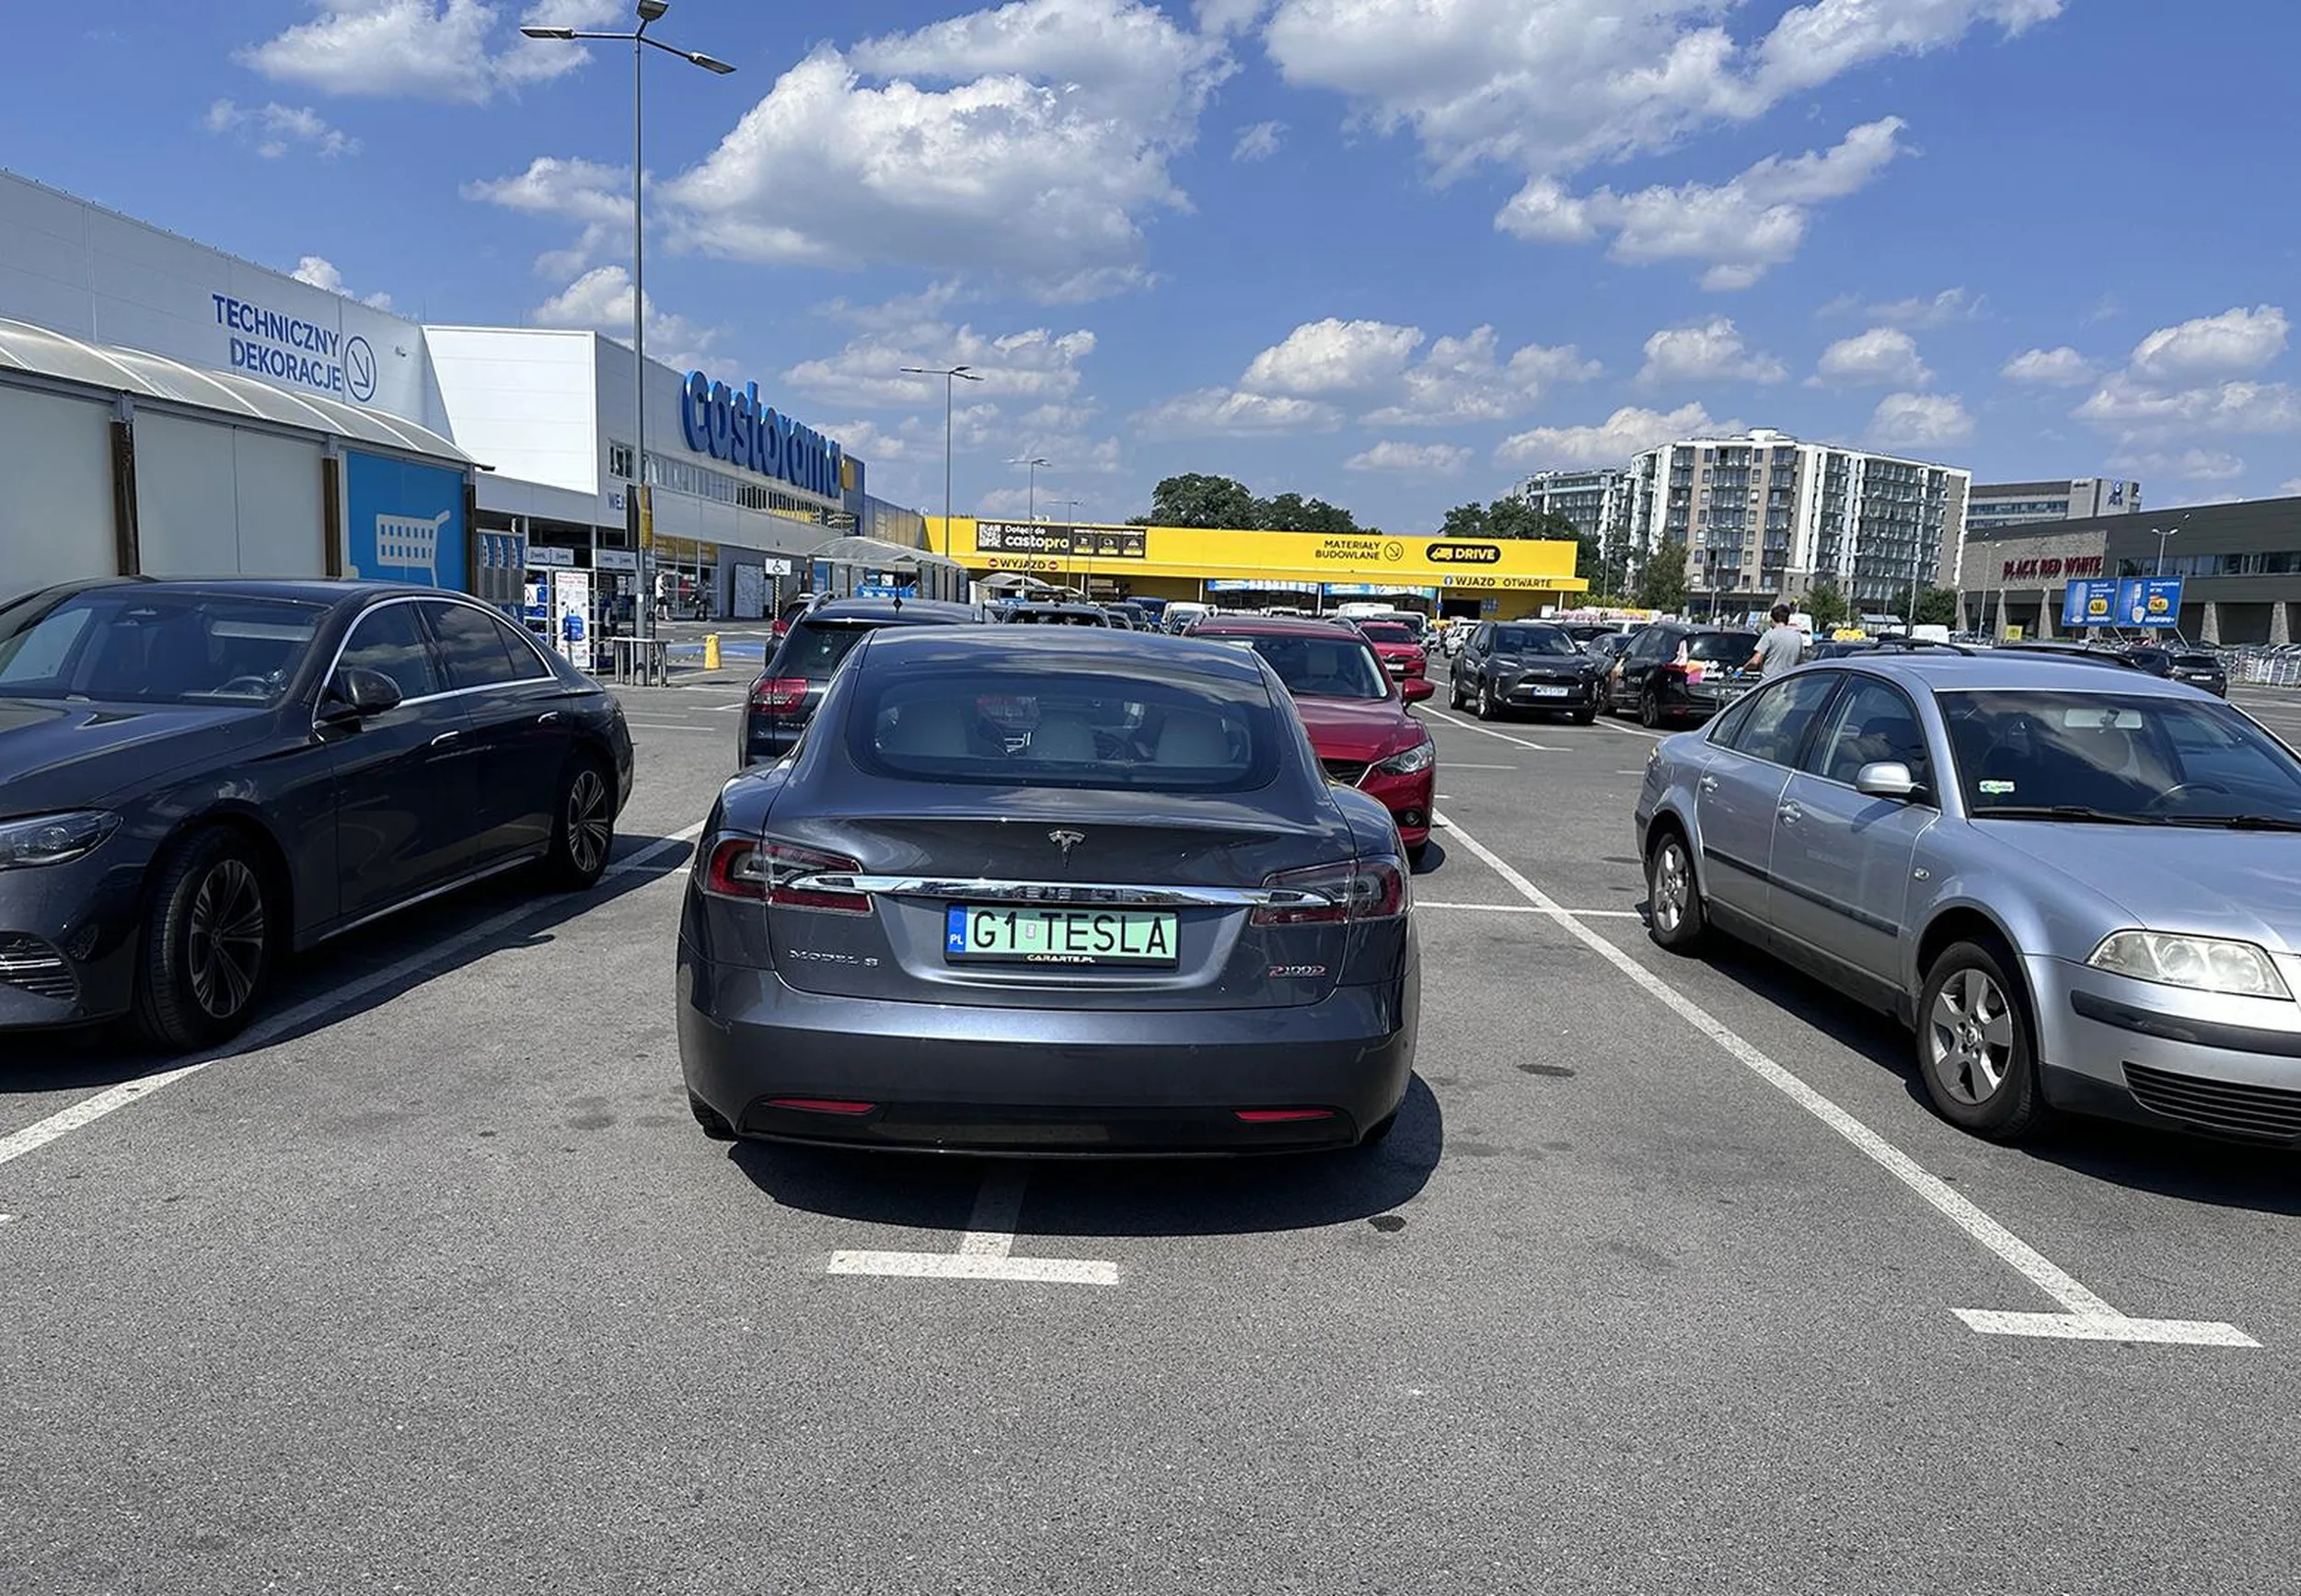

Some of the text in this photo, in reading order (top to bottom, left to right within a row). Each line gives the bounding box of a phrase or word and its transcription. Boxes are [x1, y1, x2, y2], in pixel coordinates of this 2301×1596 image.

[212, 294, 339, 357] TECHNICZNY
[230, 337, 342, 391] DEKORACJE
[682, 370, 841, 498] castorama
[1005, 535, 1070, 552] castopro
[1324, 540, 1381, 550] MATERIAŁY
[1315, 549, 1381, 561] BUDOWLANE
[1454, 549, 1496, 561] DRIVE
[1000, 559, 1046, 570] WYJAZD
[2003, 556, 2102, 578] BLACK RED WHITE
[1456, 577, 1553, 588] WJAZD OTWARTE
[950, 934, 964, 945] PL
[973, 910, 1168, 954] G1 TESLA
[790, 949, 859, 965] MODEL
